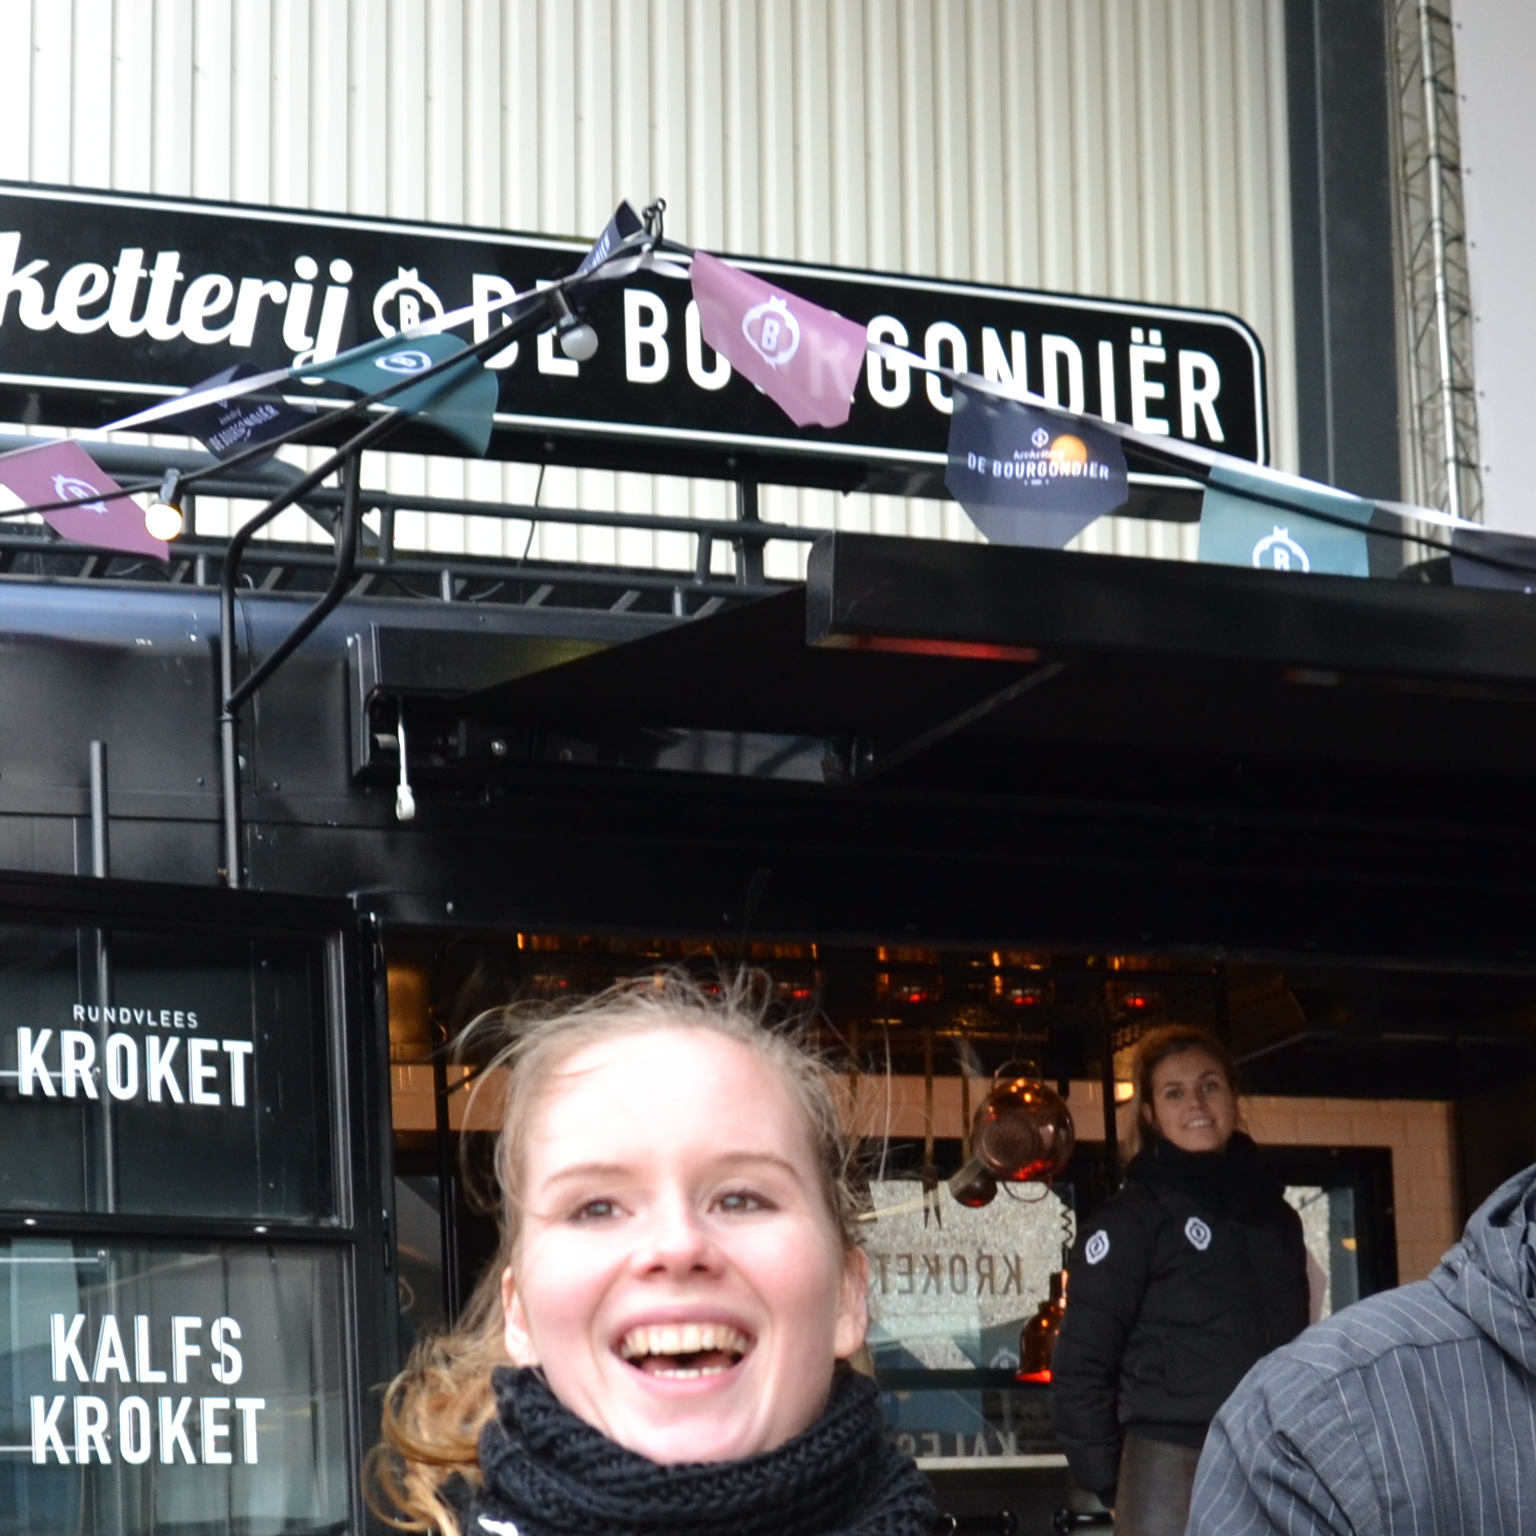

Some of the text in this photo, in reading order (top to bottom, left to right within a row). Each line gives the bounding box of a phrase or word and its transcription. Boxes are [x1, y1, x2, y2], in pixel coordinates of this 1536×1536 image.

[967, 451, 986, 475] DE
[72, 1002, 199, 1029] RUNDVLEES
[16, 1026, 253, 1107] KROKET
[49, 1312, 243, 1384] KALFS
[29, 1394, 266, 1465] KROKET
